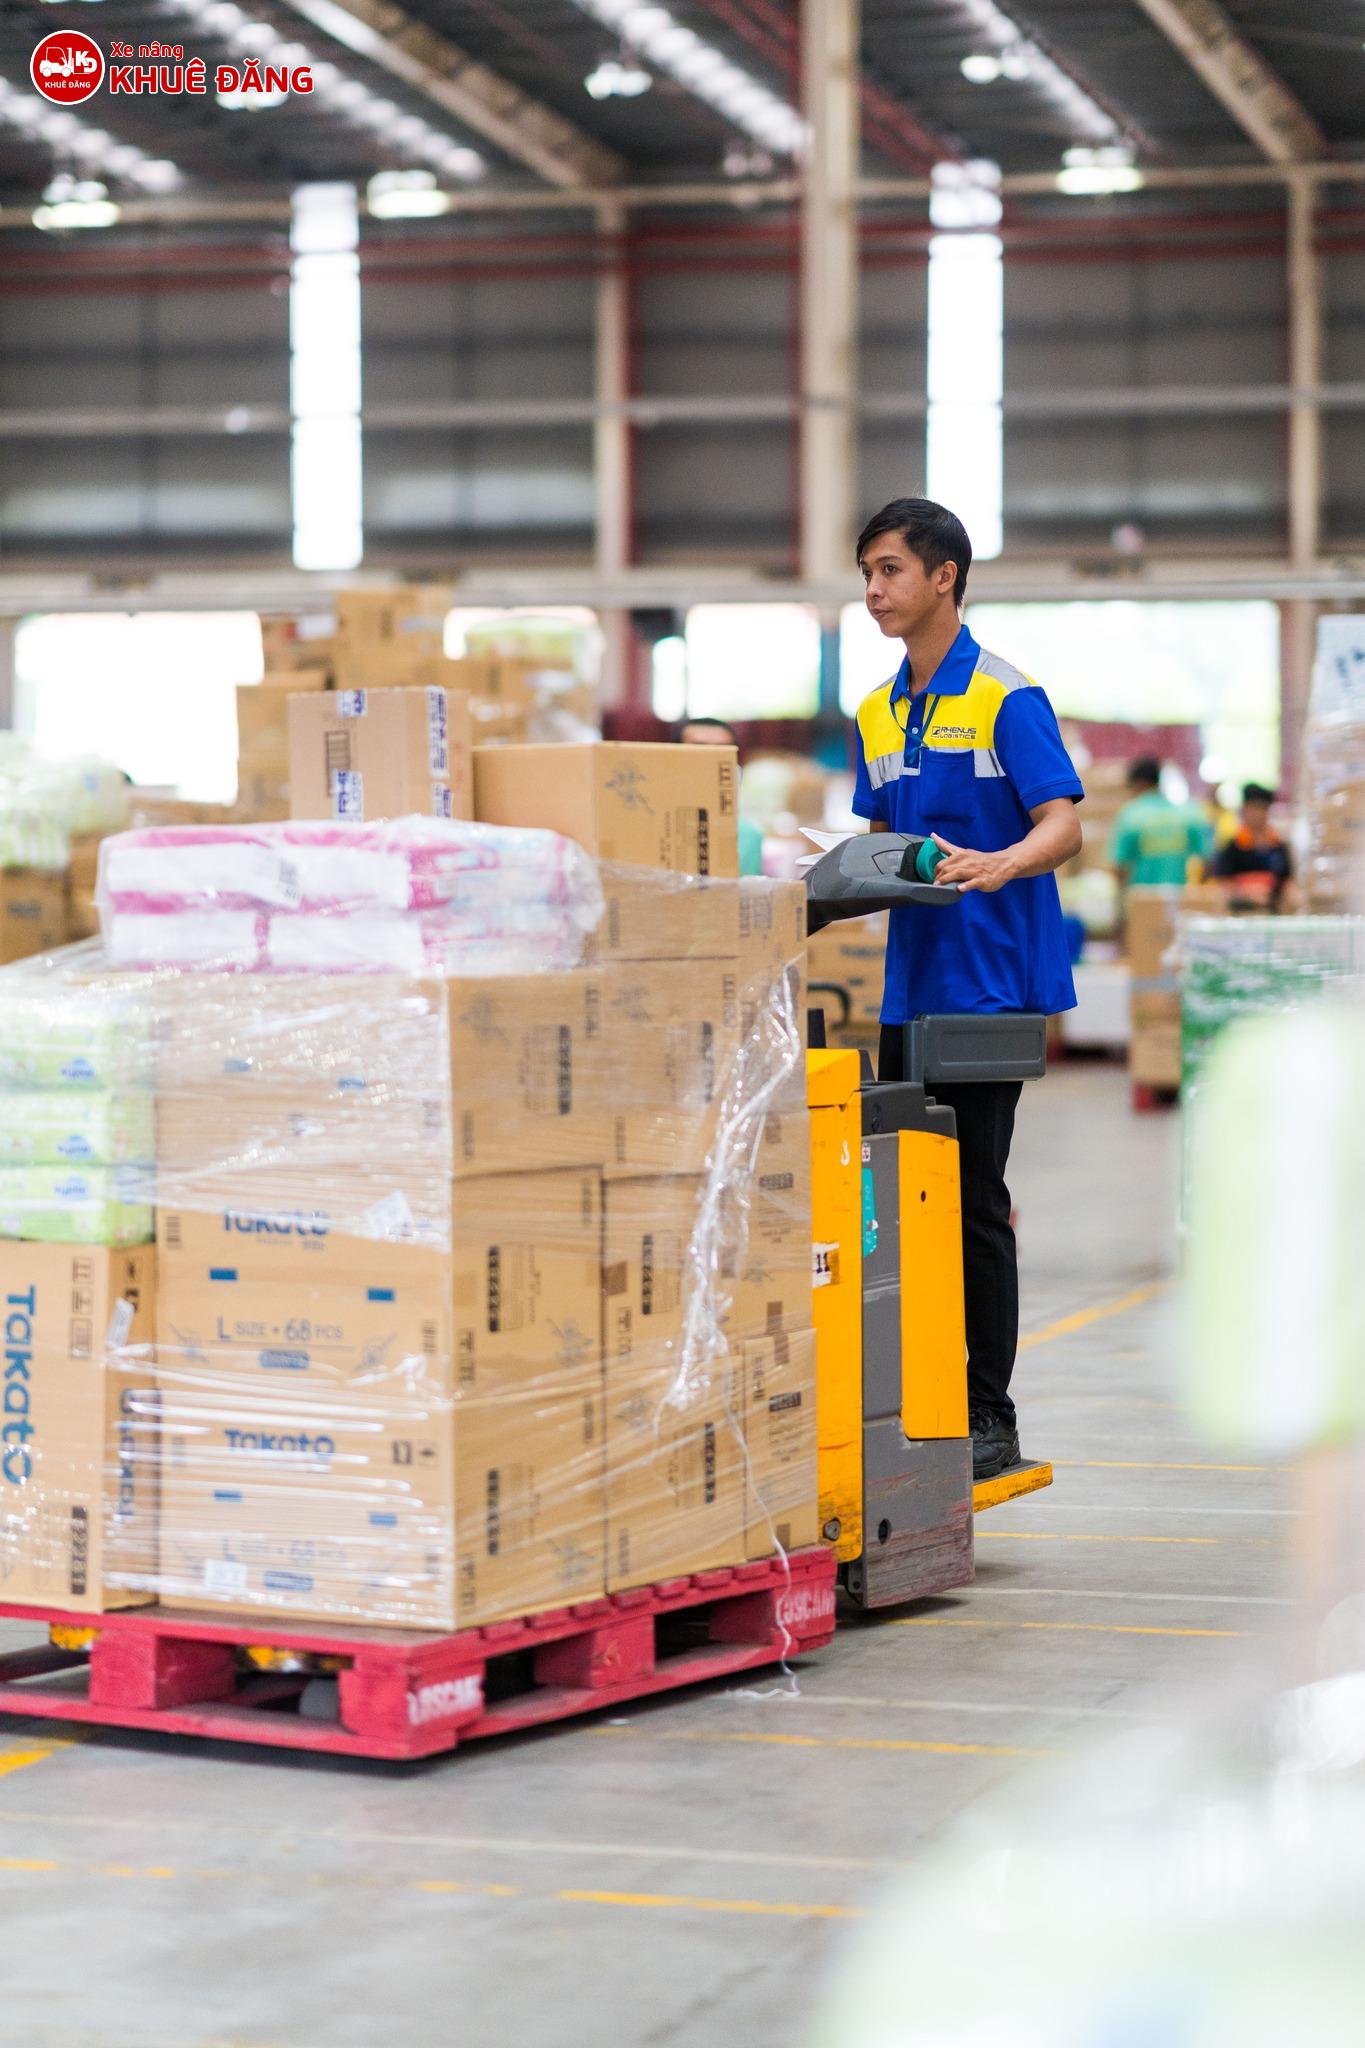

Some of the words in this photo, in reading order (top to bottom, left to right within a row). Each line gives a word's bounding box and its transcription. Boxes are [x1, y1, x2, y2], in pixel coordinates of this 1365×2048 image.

[940, 726, 977, 734] RHENUS
[284, 1318, 312, 1342] 68
[1, 1284, 36, 1485] Takato
